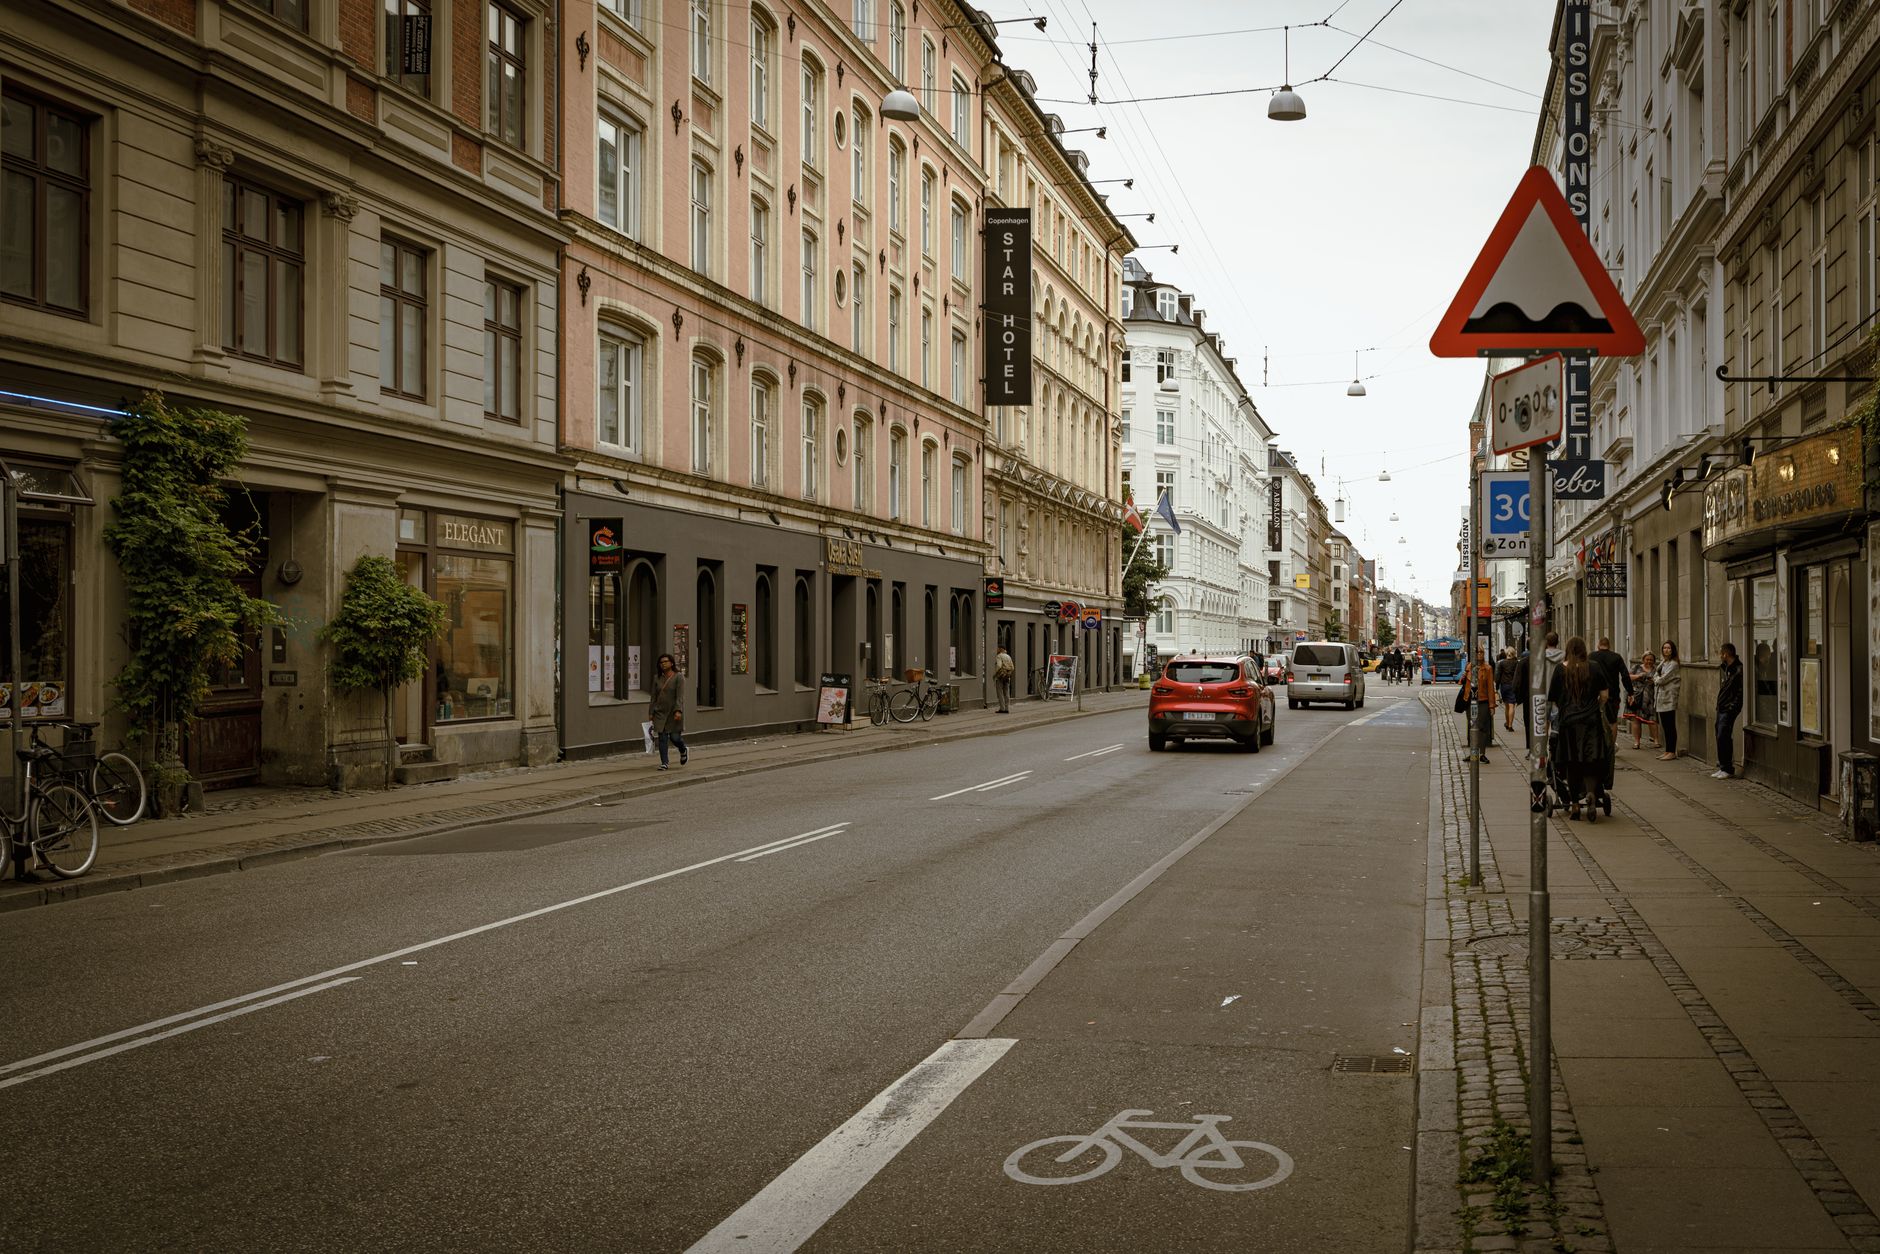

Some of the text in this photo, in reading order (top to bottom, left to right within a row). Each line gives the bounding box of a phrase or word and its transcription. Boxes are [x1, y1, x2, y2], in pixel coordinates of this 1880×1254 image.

[1002, 232, 1015, 394] STAR HOTEL
[1545, 464, 1601, 493] ebo
[444, 522, 504, 546] ELEGANT
[1498, 538, 1526, 550] Zon
